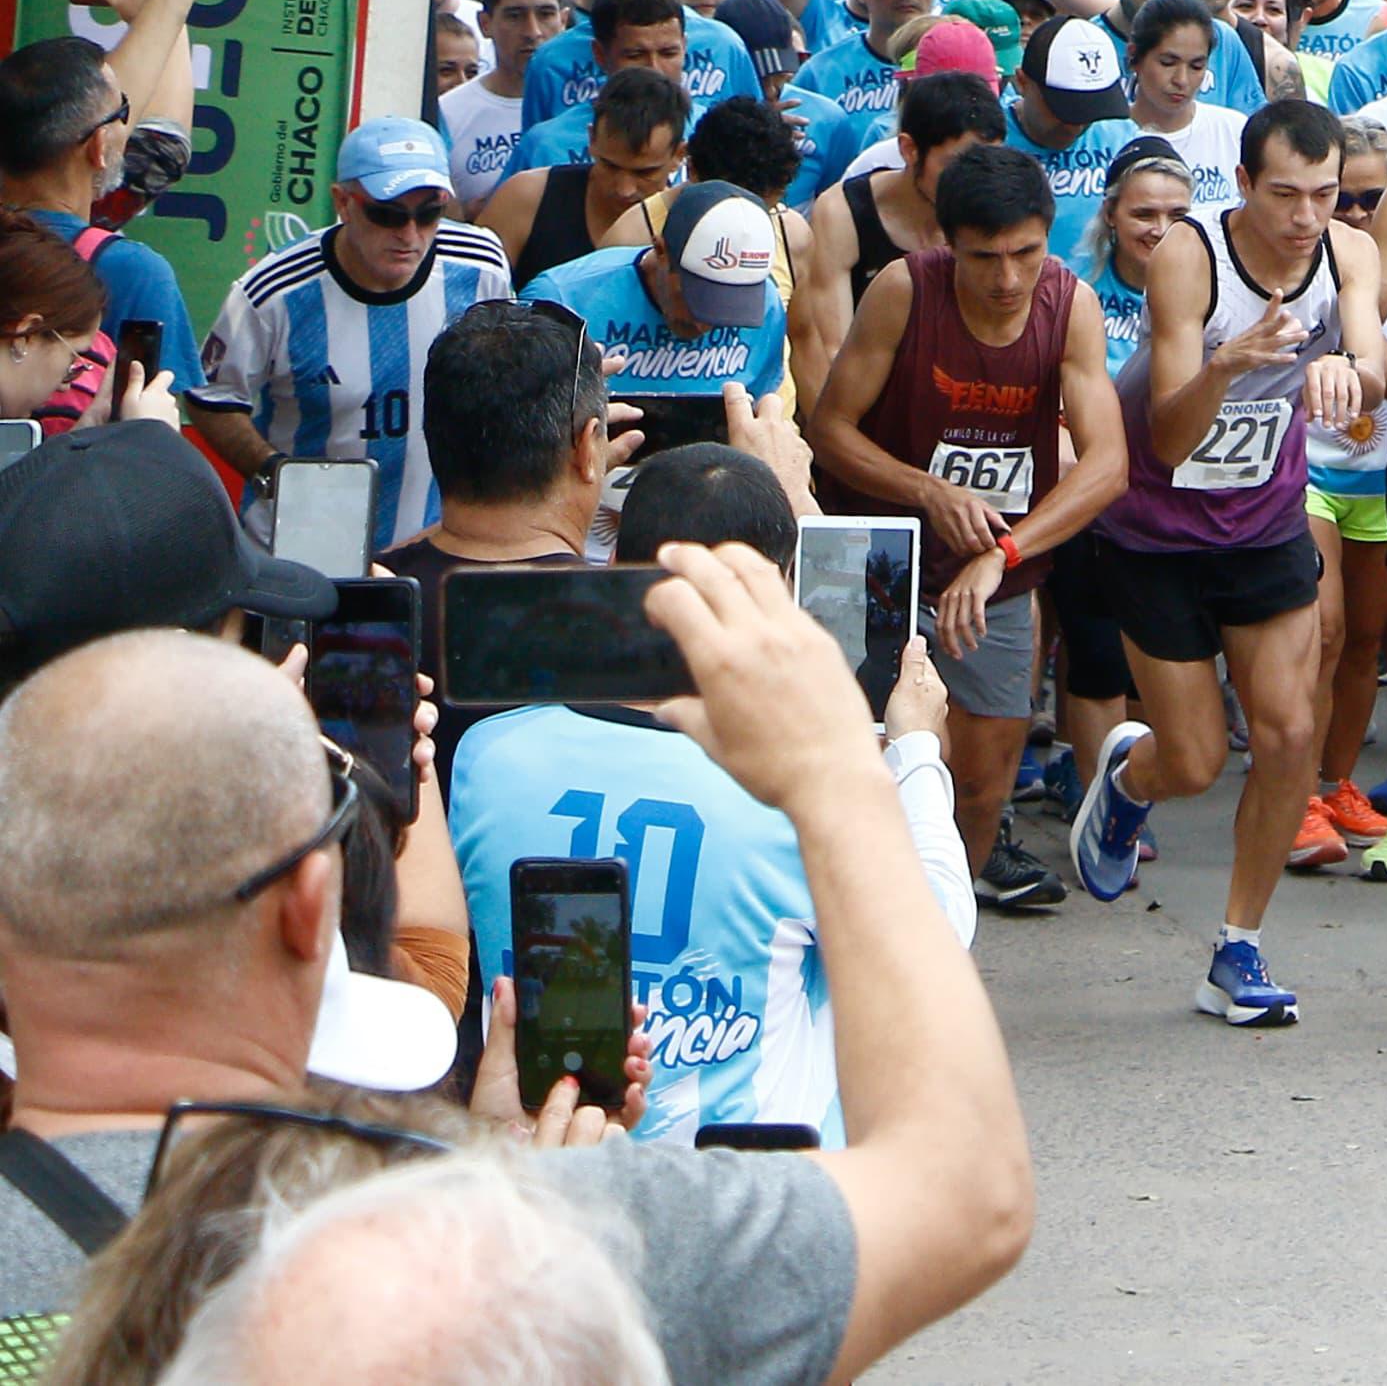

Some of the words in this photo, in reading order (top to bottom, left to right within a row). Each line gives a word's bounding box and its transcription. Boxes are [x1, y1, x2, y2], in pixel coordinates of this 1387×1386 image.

[286, 66, 324, 205] CHACO
[360, 389, 410, 440] 10
[943, 427, 971, 440] CAMILO
[974, 429, 985, 441] DE
[987, 430, 998, 442] LA
[1190, 415, 1281, 465] 221
[942, 450, 1026, 493] 667
